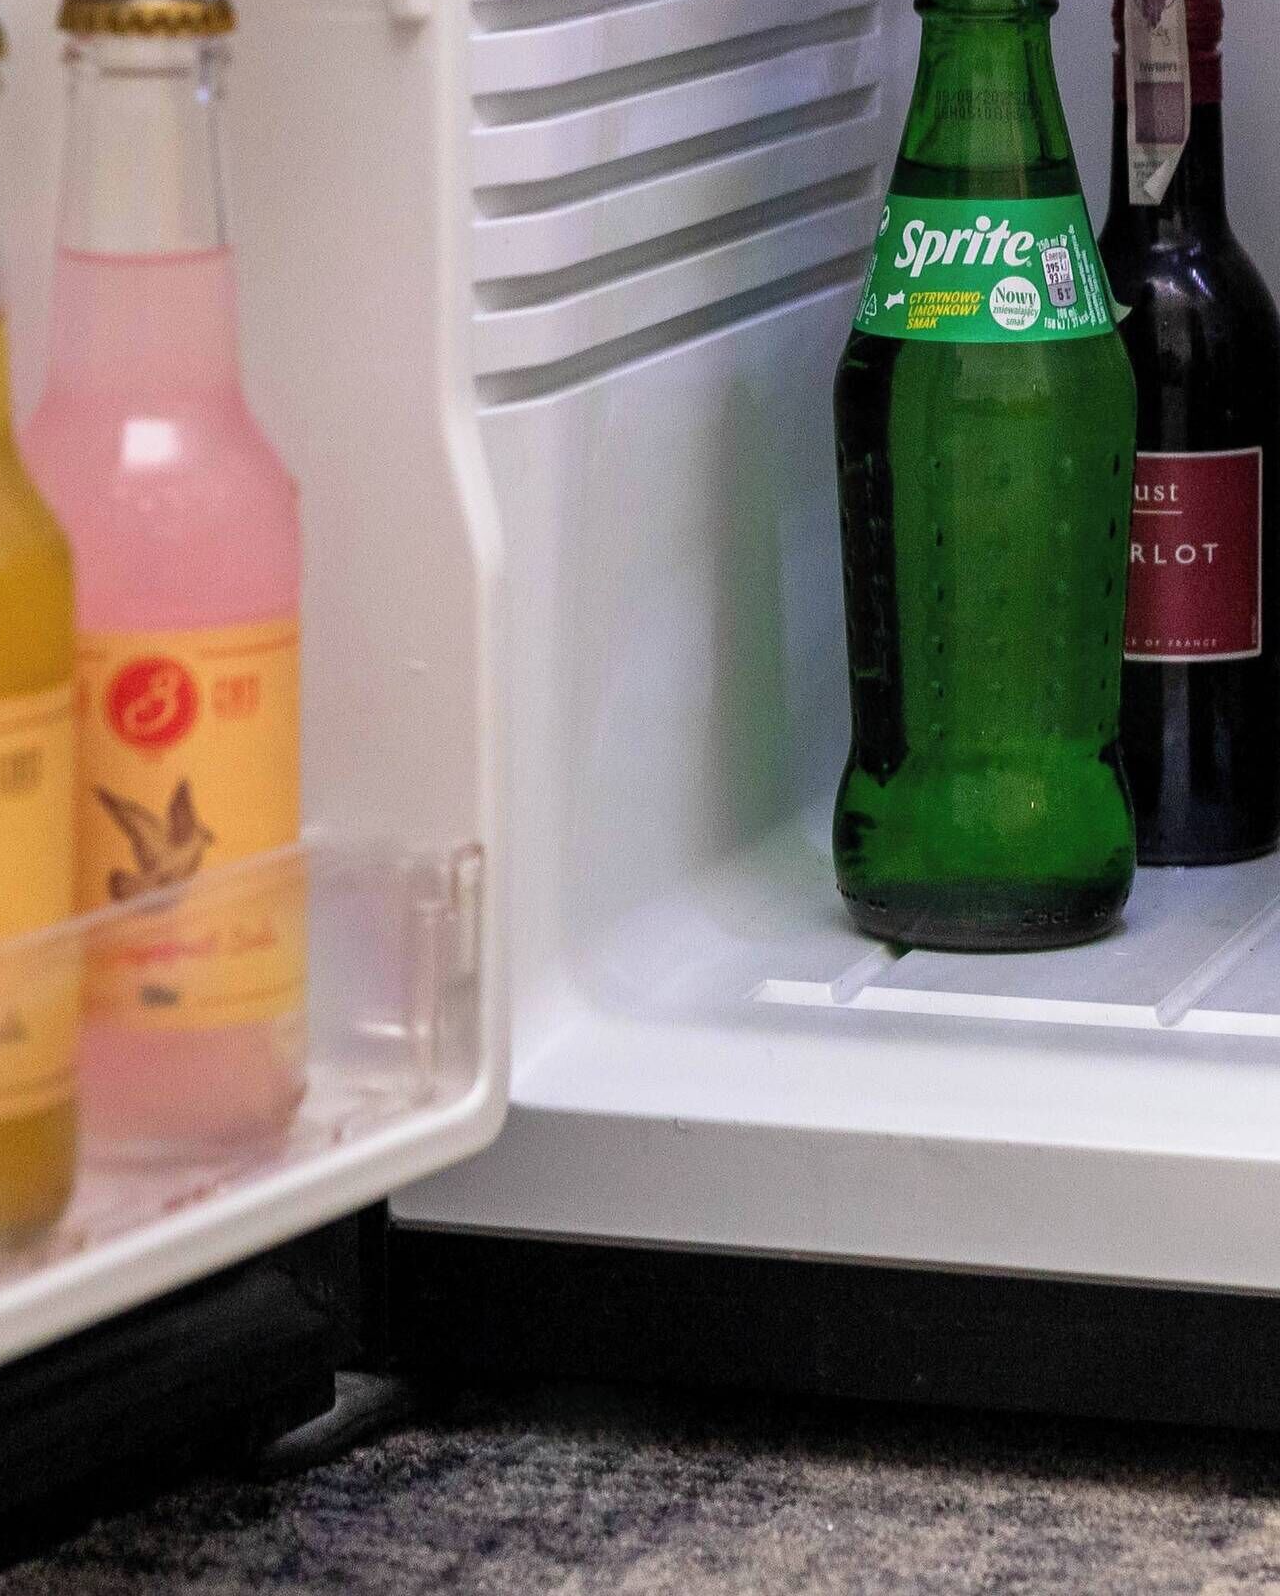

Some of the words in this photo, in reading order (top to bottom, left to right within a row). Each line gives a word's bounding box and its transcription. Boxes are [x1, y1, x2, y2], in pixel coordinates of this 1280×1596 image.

[894, 215, 1035, 278] Sprite
[1046, 261, 1060, 274] 395
[1049, 272, 1059, 284] 93
[909, 290, 986, 306] CYTRYNOWO-
[995, 286, 1037, 307] Nowy
[907, 303, 981, 318] LIMONKOWY
[906, 316, 939, 330] SMAK
[1134, 482, 1180, 502] ust
[1129, 542, 1220, 565] RLOT
